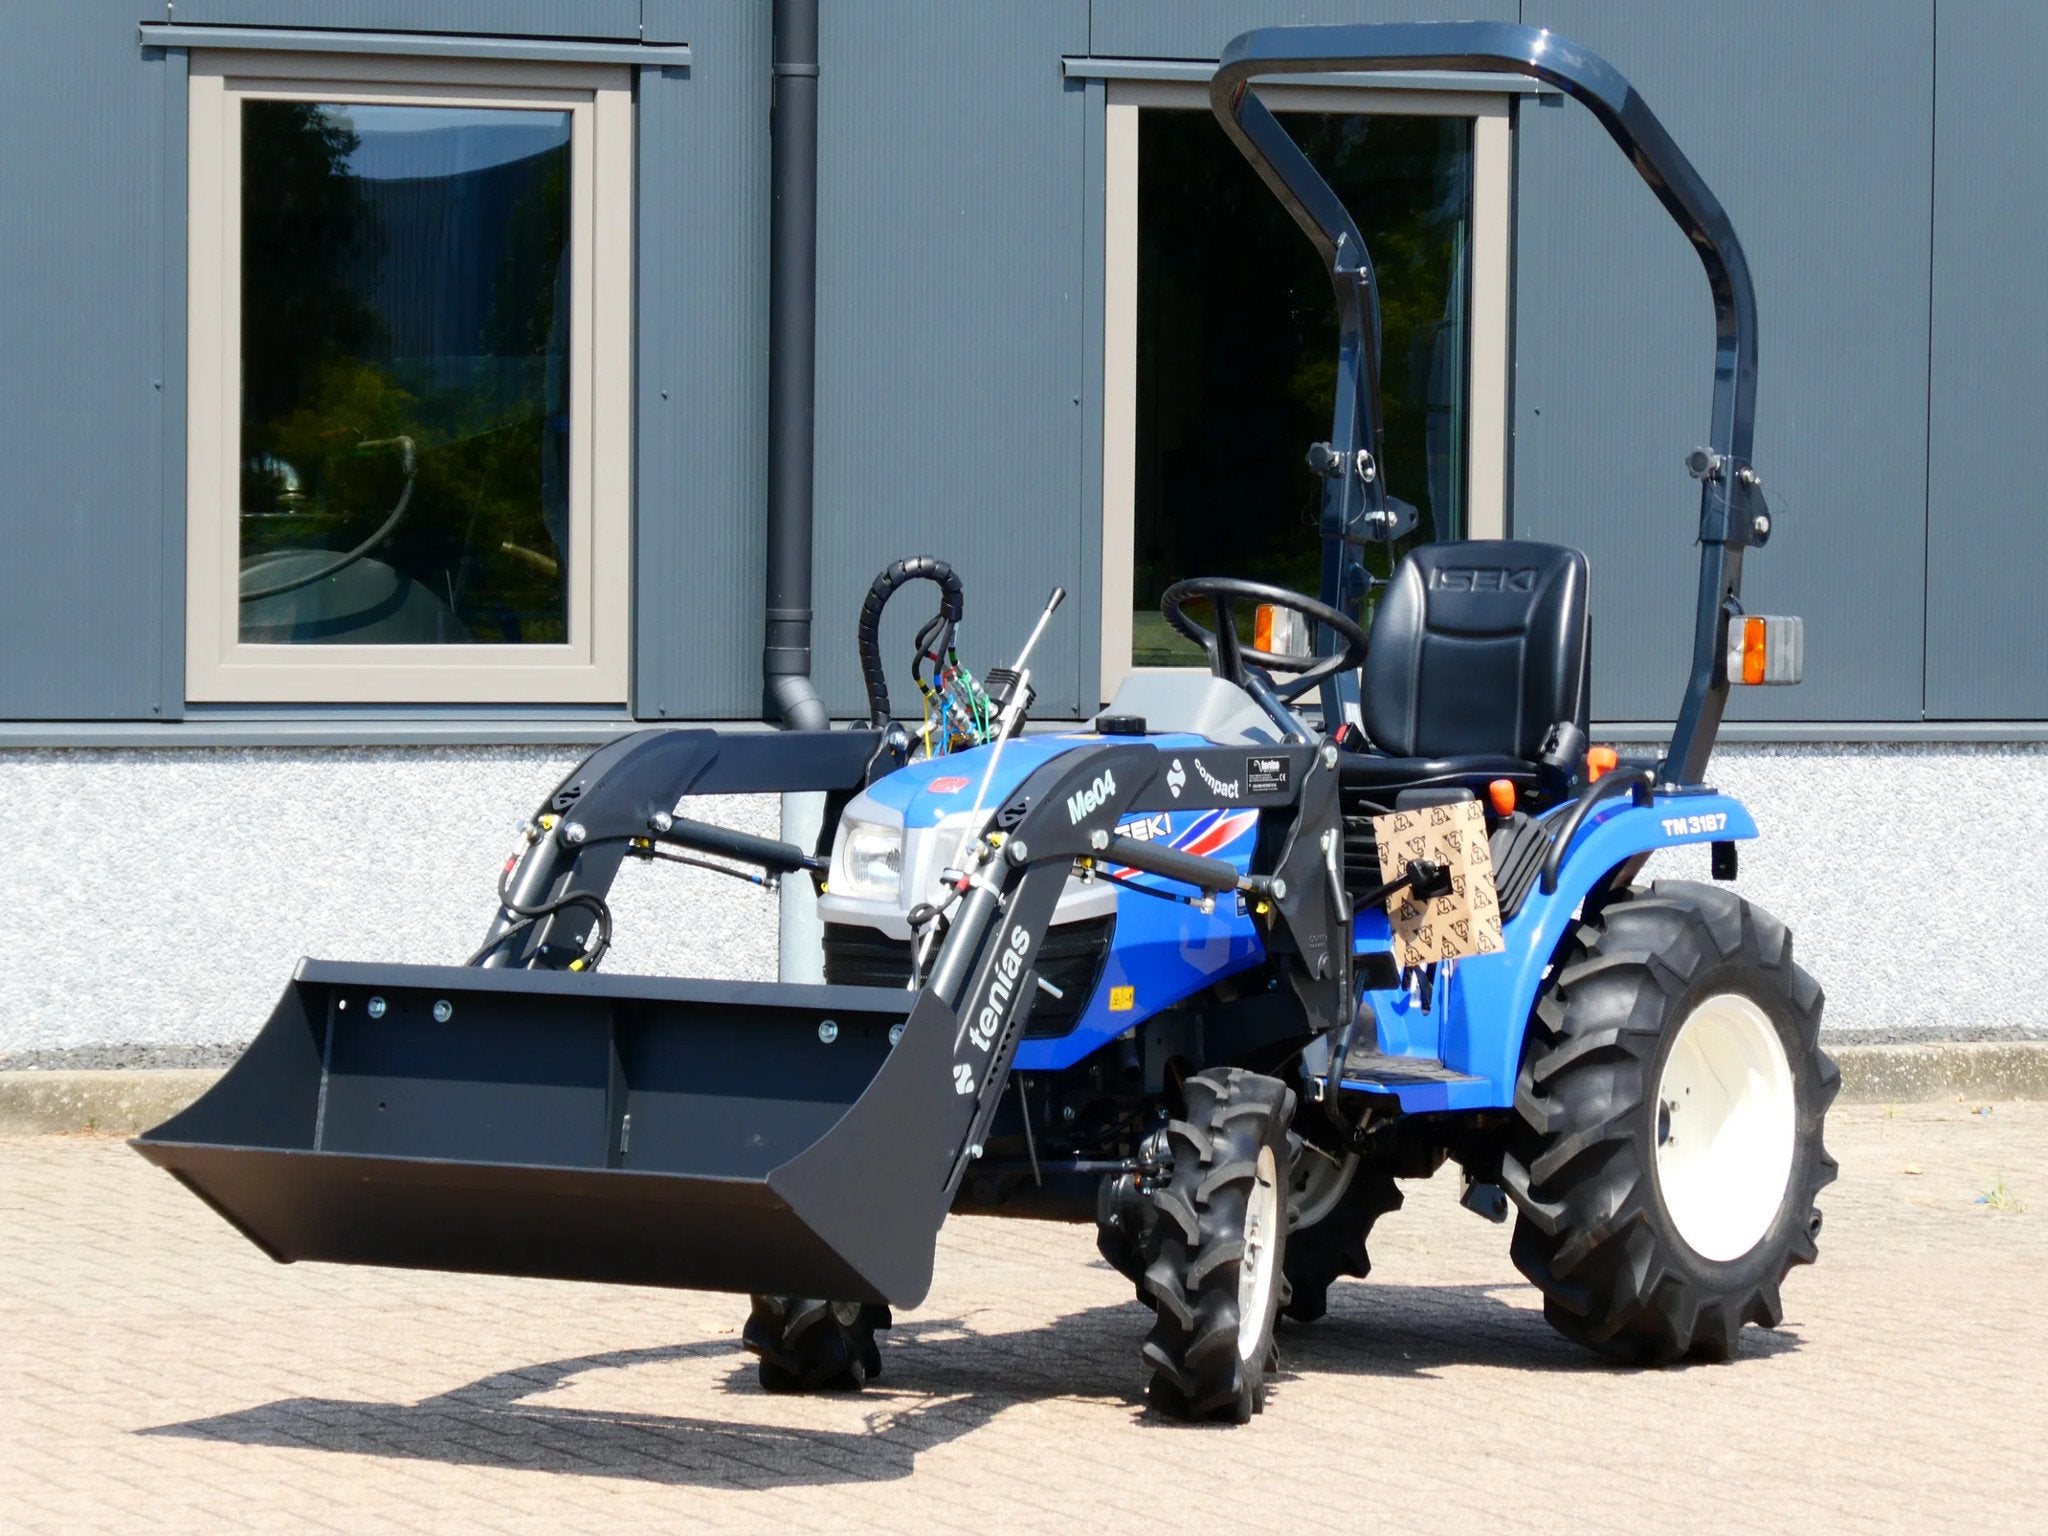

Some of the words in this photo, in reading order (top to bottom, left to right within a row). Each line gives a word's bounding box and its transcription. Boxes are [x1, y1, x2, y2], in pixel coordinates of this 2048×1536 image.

[1428, 567, 1538, 592] ISEKI
[1194, 758, 1239, 799] compact
[1067, 769, 1116, 826] Me04
[1114, 812, 1171, 841] SEKI
